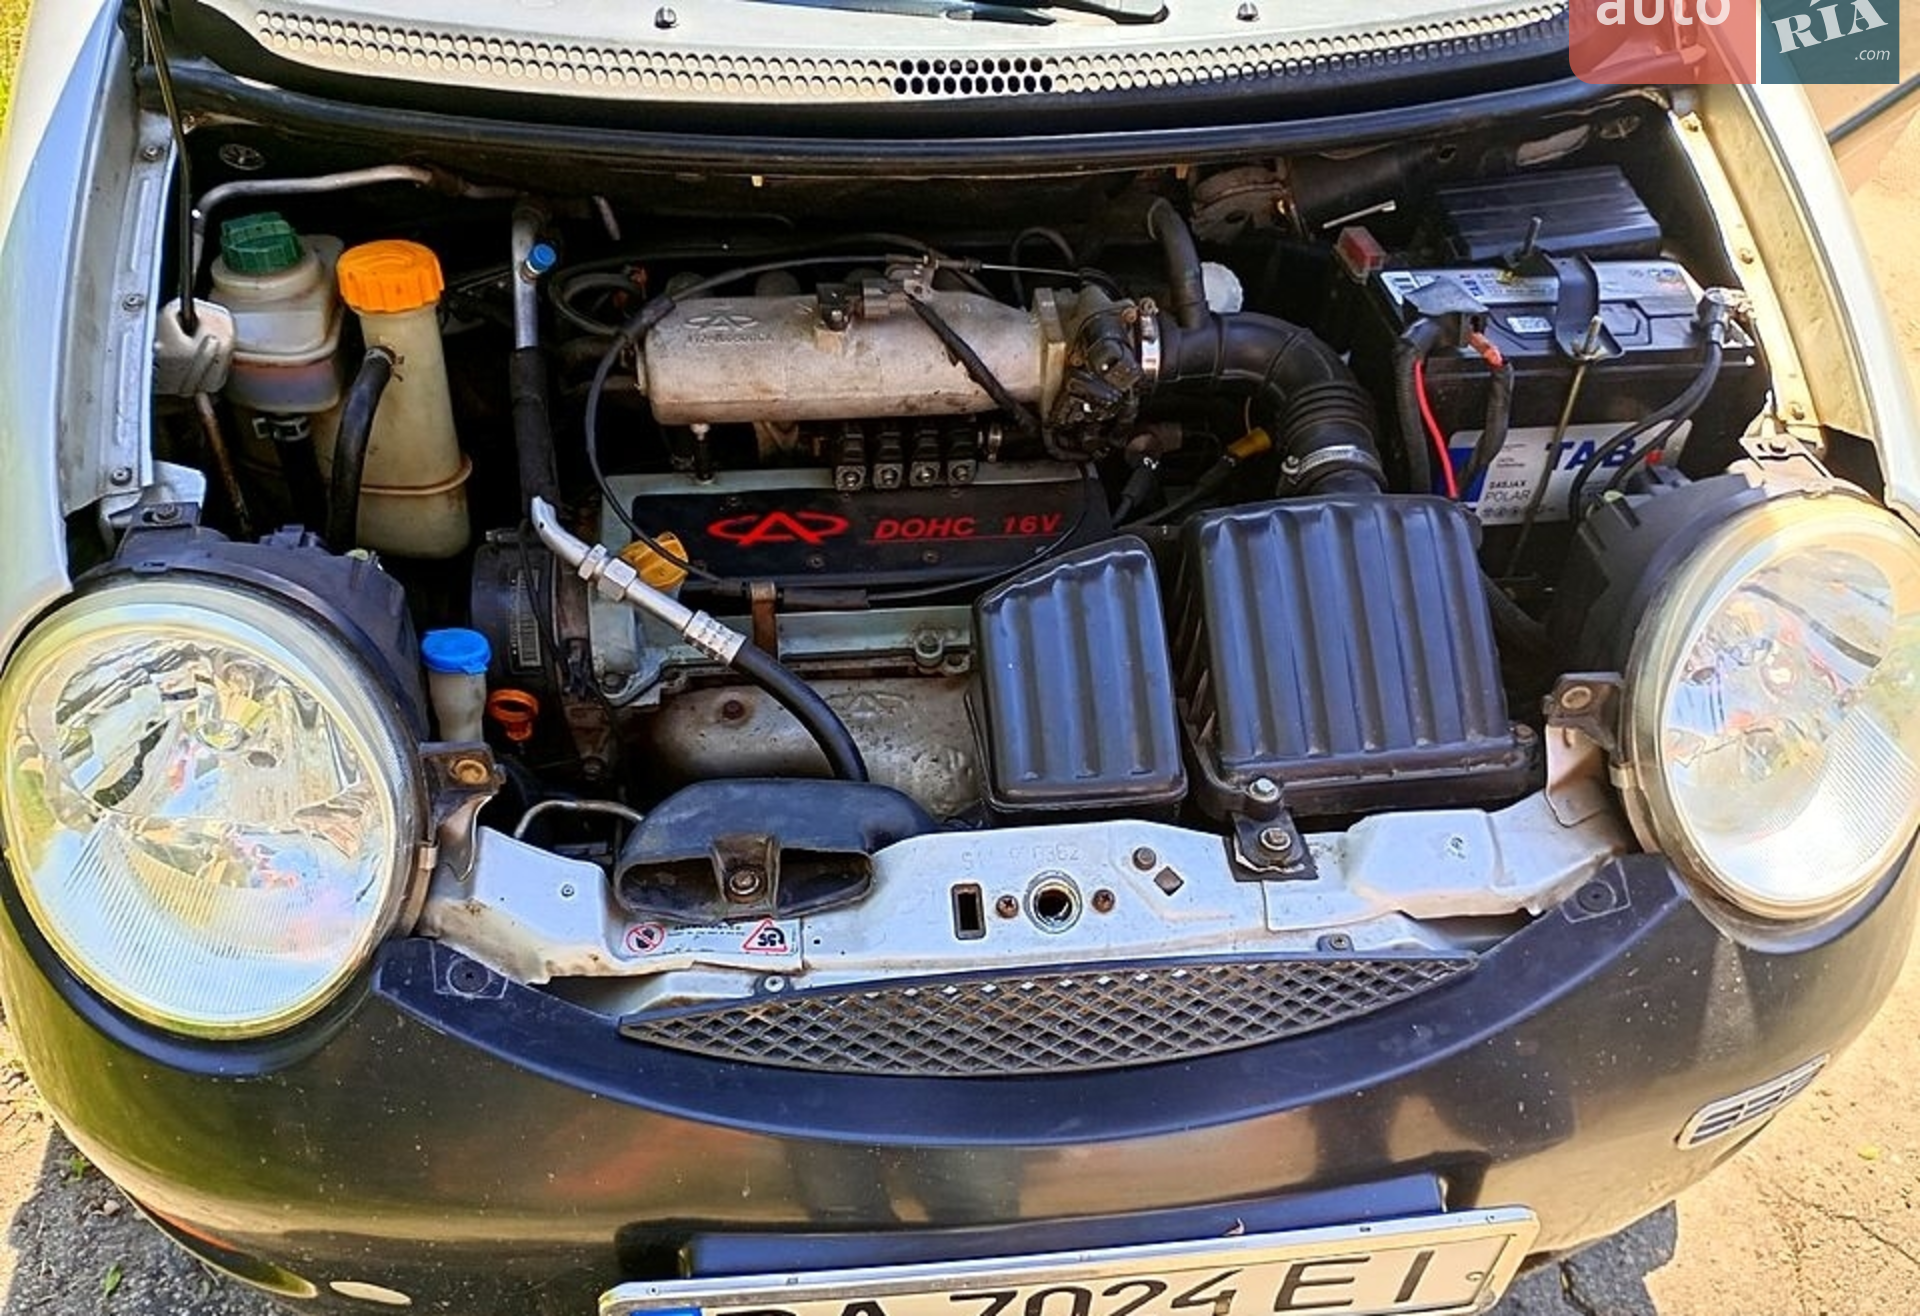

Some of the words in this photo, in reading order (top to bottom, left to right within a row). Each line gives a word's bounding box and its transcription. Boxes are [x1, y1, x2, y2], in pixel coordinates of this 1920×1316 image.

[1545, 437, 1635, 470] TAB
[1485, 489, 1531, 501] POLAR
[875, 517, 976, 540] DOHC
[1003, 514, 1062, 534] 16V
